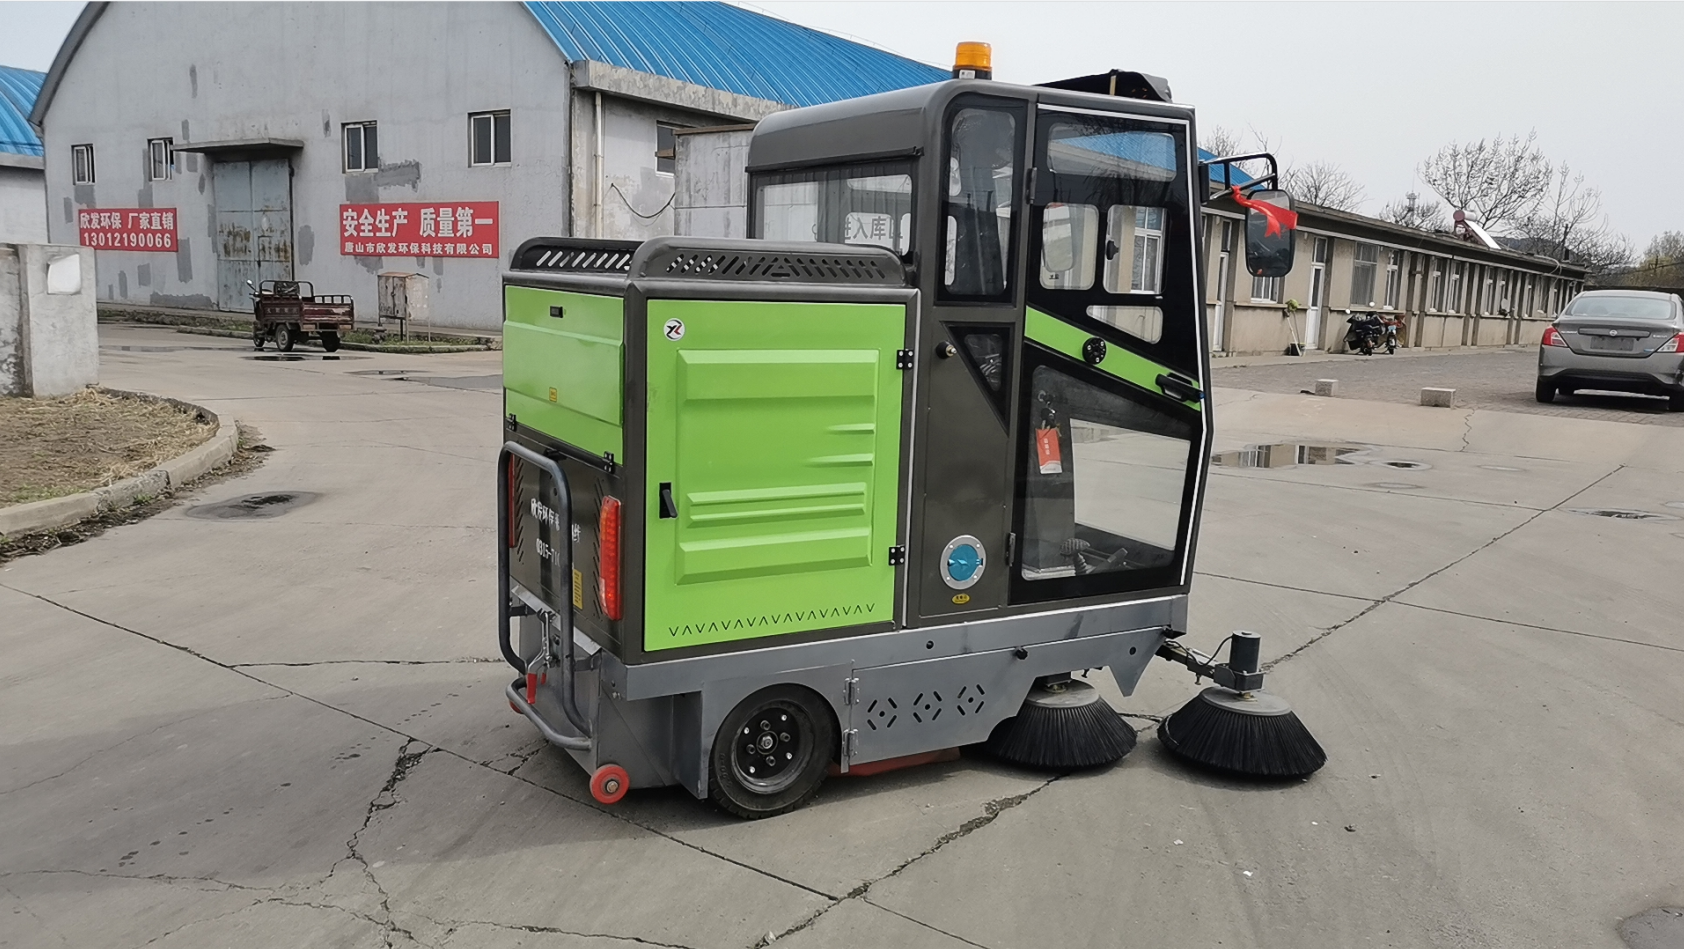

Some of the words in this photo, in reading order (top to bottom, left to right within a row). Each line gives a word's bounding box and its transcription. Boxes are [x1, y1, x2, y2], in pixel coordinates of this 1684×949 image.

[80, 212, 122, 229] 欣发环保
[128, 212, 174, 230] 厂家直销
[343, 207, 408, 237] 安全生产
[419, 207, 493, 238] 质量第一
[83, 232, 171, 248] 13012190066
[345, 241, 493, 255] 唐山市欣发环保科技有限公司
